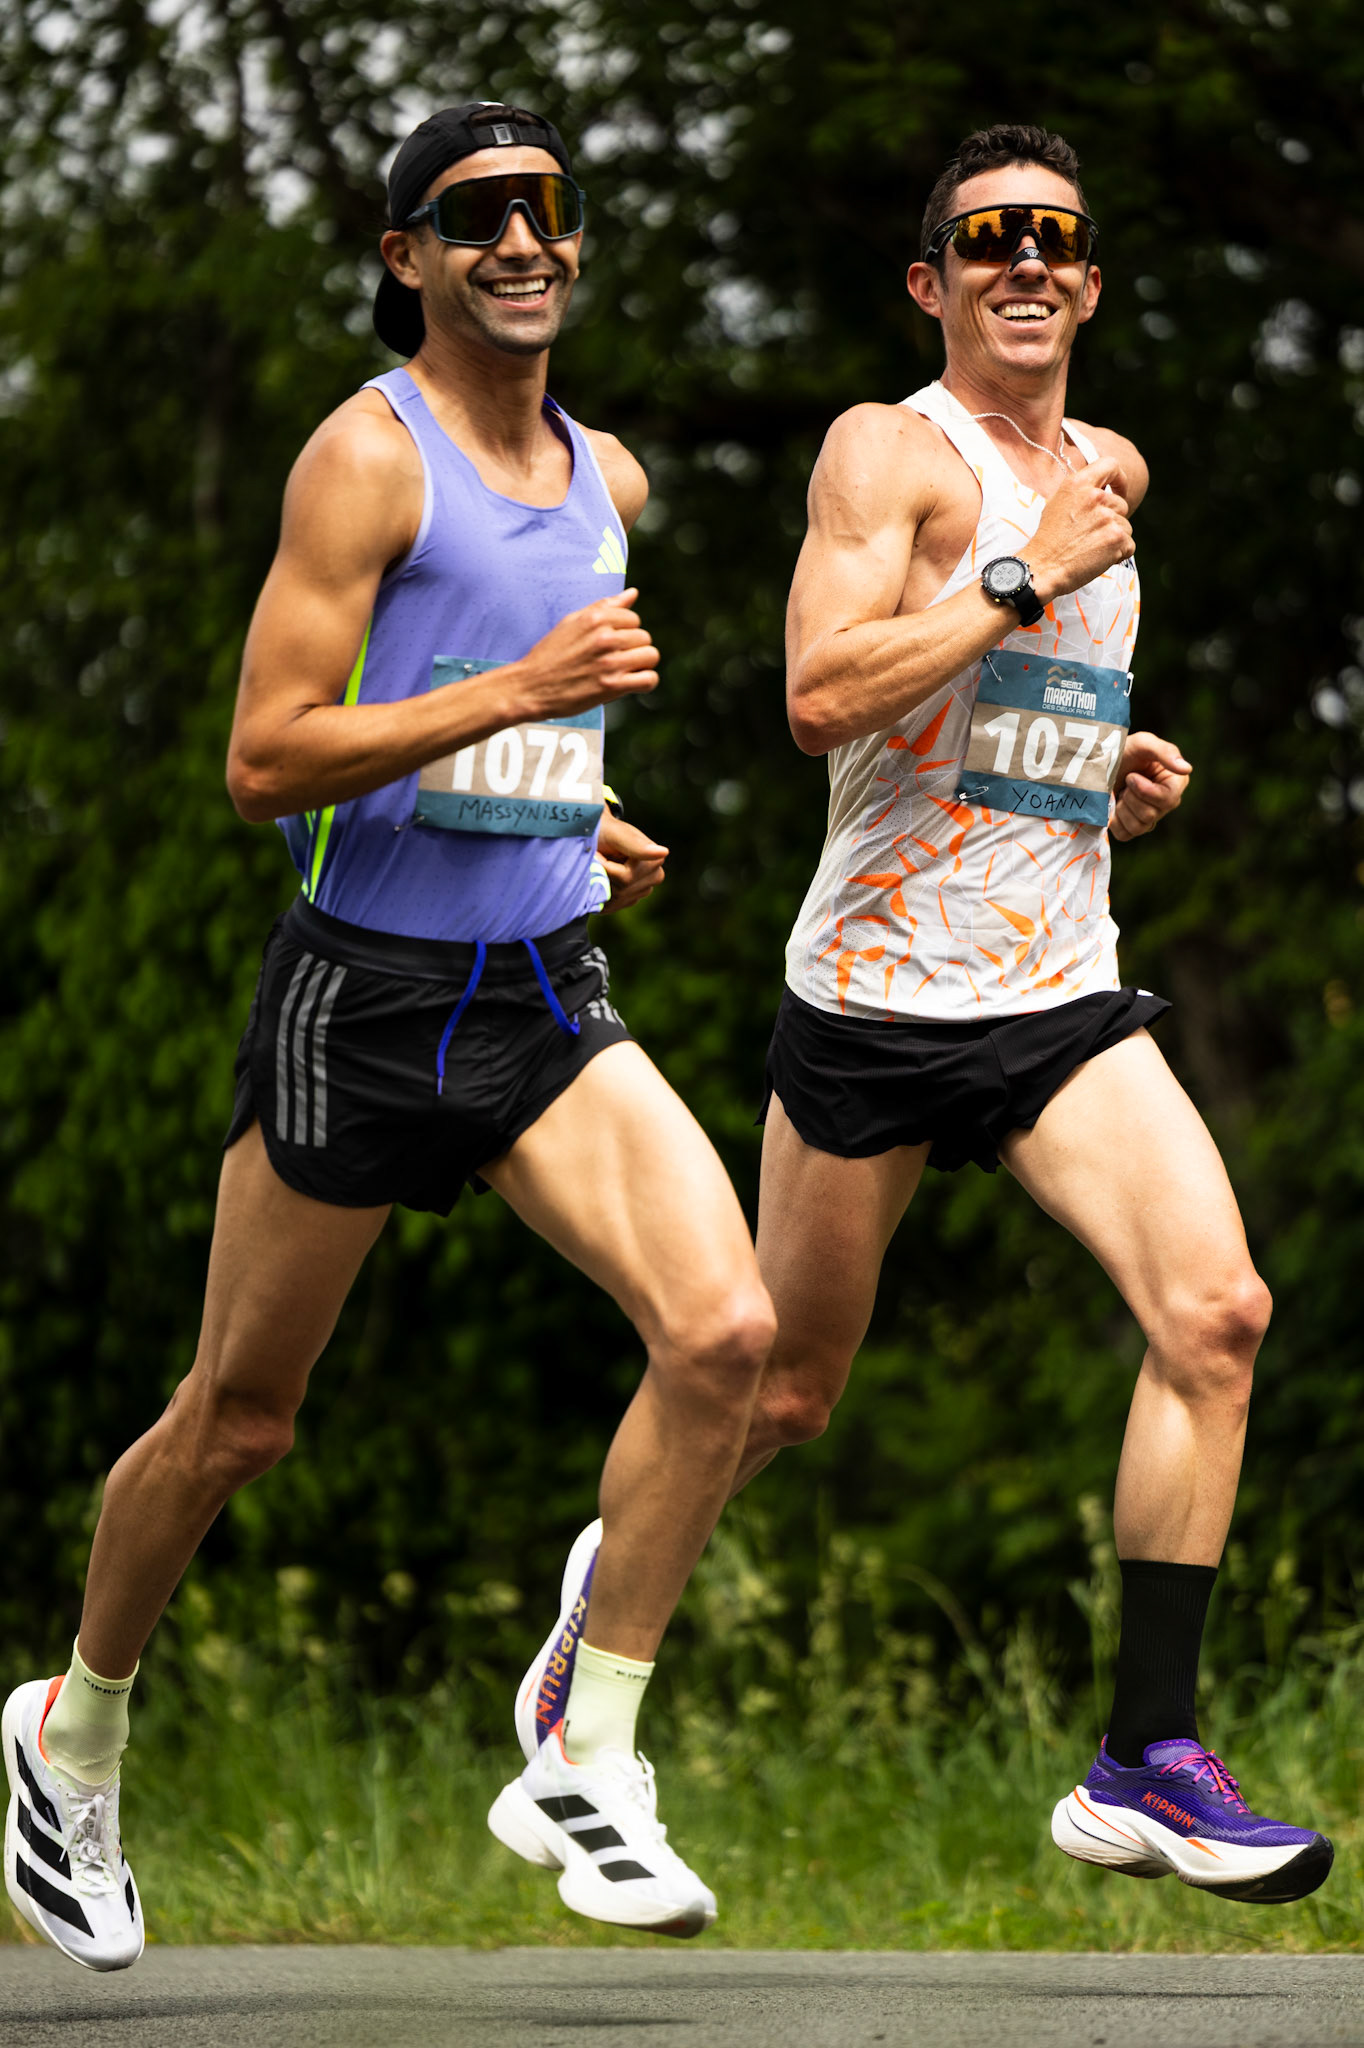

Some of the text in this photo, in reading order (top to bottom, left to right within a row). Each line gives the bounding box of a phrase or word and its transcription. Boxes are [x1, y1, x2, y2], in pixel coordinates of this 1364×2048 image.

[1060, 679, 1084, 691] SEMI
[1041, 703, 1096, 717] DES DEUX RIVES
[1043, 686, 1097, 711] MARATHON
[983, 711, 1122, 785] 1071
[452, 726, 593, 801] 1072
[1012, 787, 1088, 813] YOANN
[535, 1595, 587, 1725] KIPRUN
[83, 1676, 130, 1695] KIPRUN
[1141, 1791, 1196, 1829] KIPRUN
